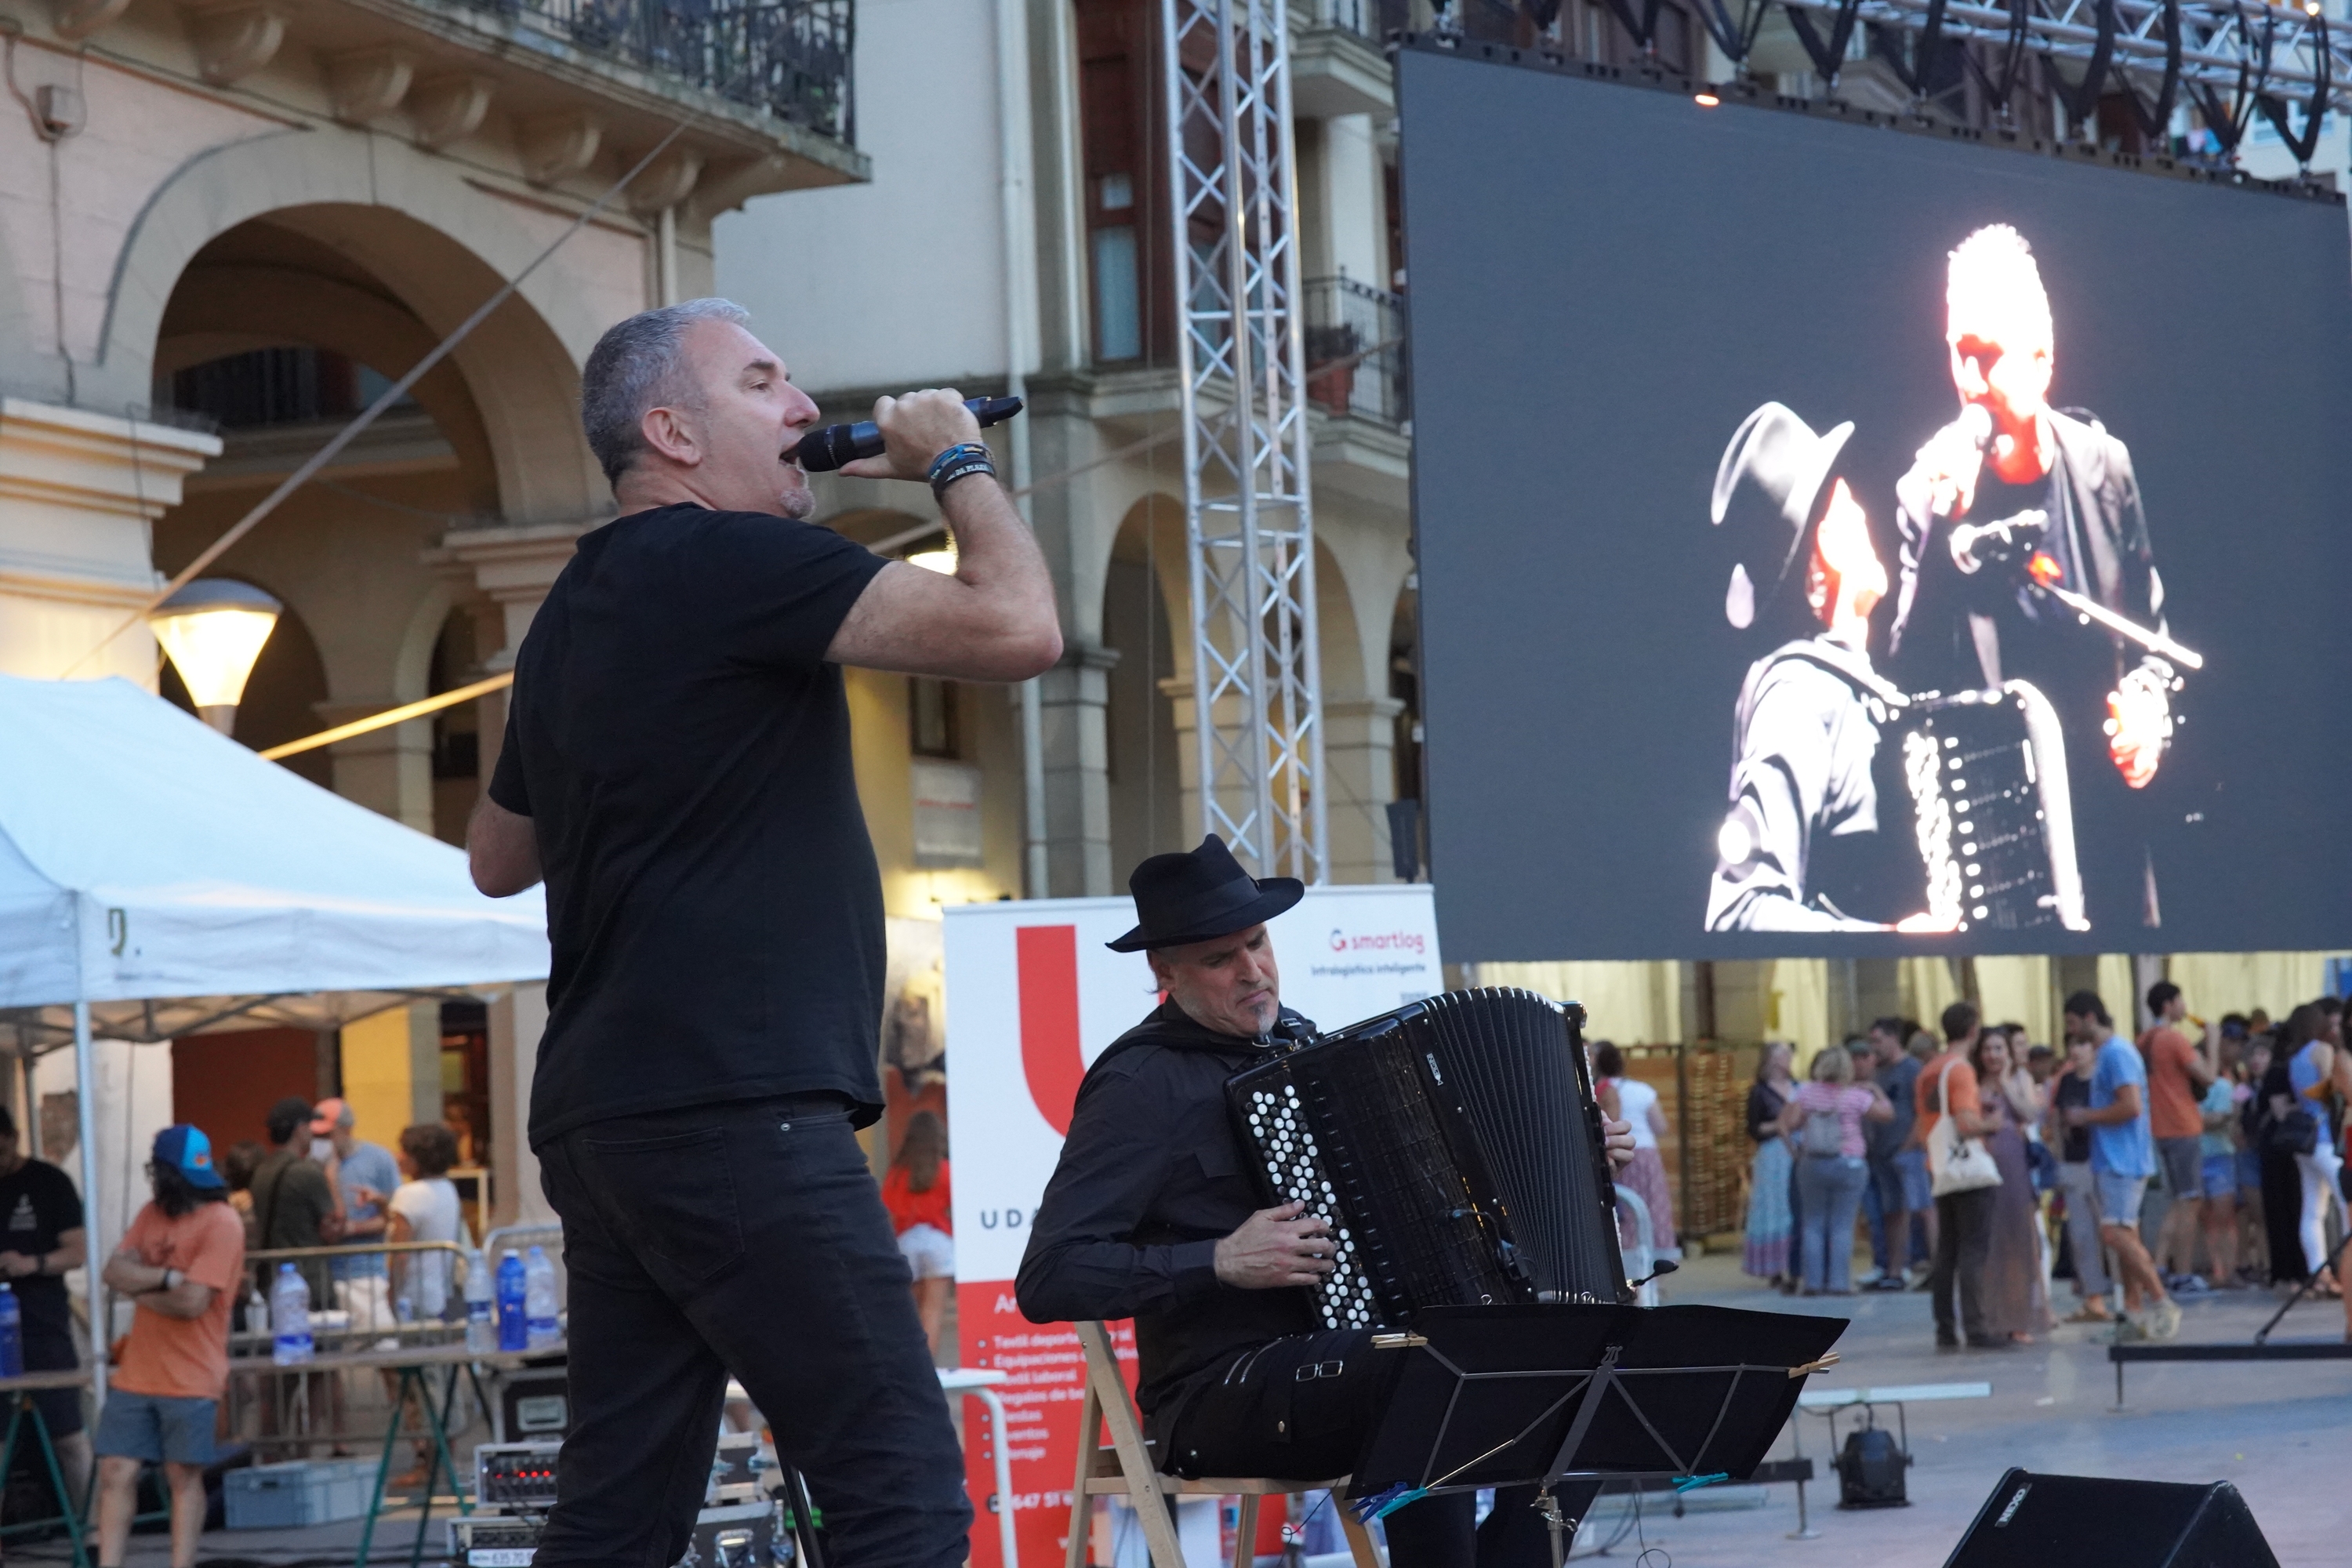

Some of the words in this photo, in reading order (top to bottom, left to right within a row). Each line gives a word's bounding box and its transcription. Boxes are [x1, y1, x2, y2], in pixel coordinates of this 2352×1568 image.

[1352, 932, 1425, 954] smartlog
[981, 1208, 1039, 1229] UD
[1999, 1488, 2026, 1522] NEXO
